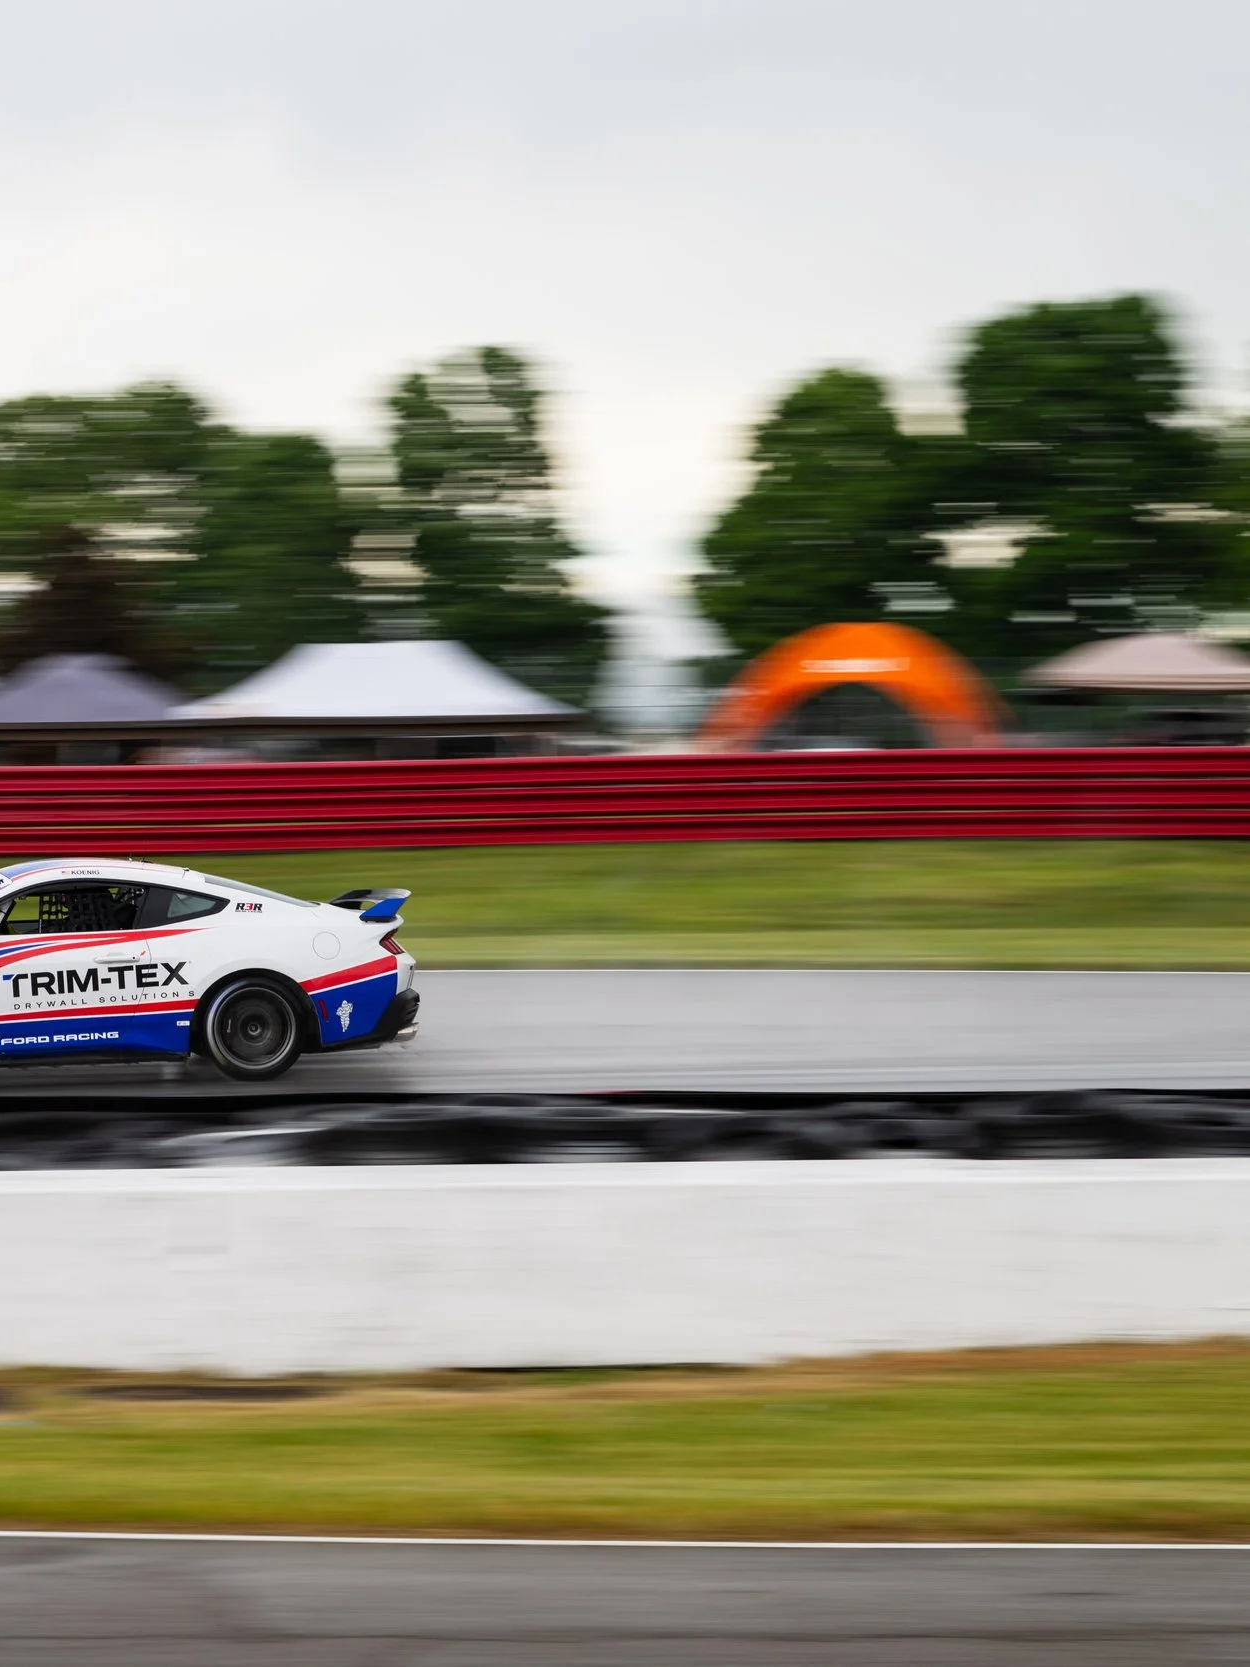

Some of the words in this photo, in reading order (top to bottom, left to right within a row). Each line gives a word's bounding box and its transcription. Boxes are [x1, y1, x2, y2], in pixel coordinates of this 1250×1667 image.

[235, 903, 263, 911] R3R
[2, 961, 189, 997] TRIM-TEX
[14, 999, 88, 1010] DRYWALL
[99, 990, 195, 1003] SOLUTIONS
[1, 1036, 49, 1045] FORD
[53, 1031, 120, 1042] RACING
